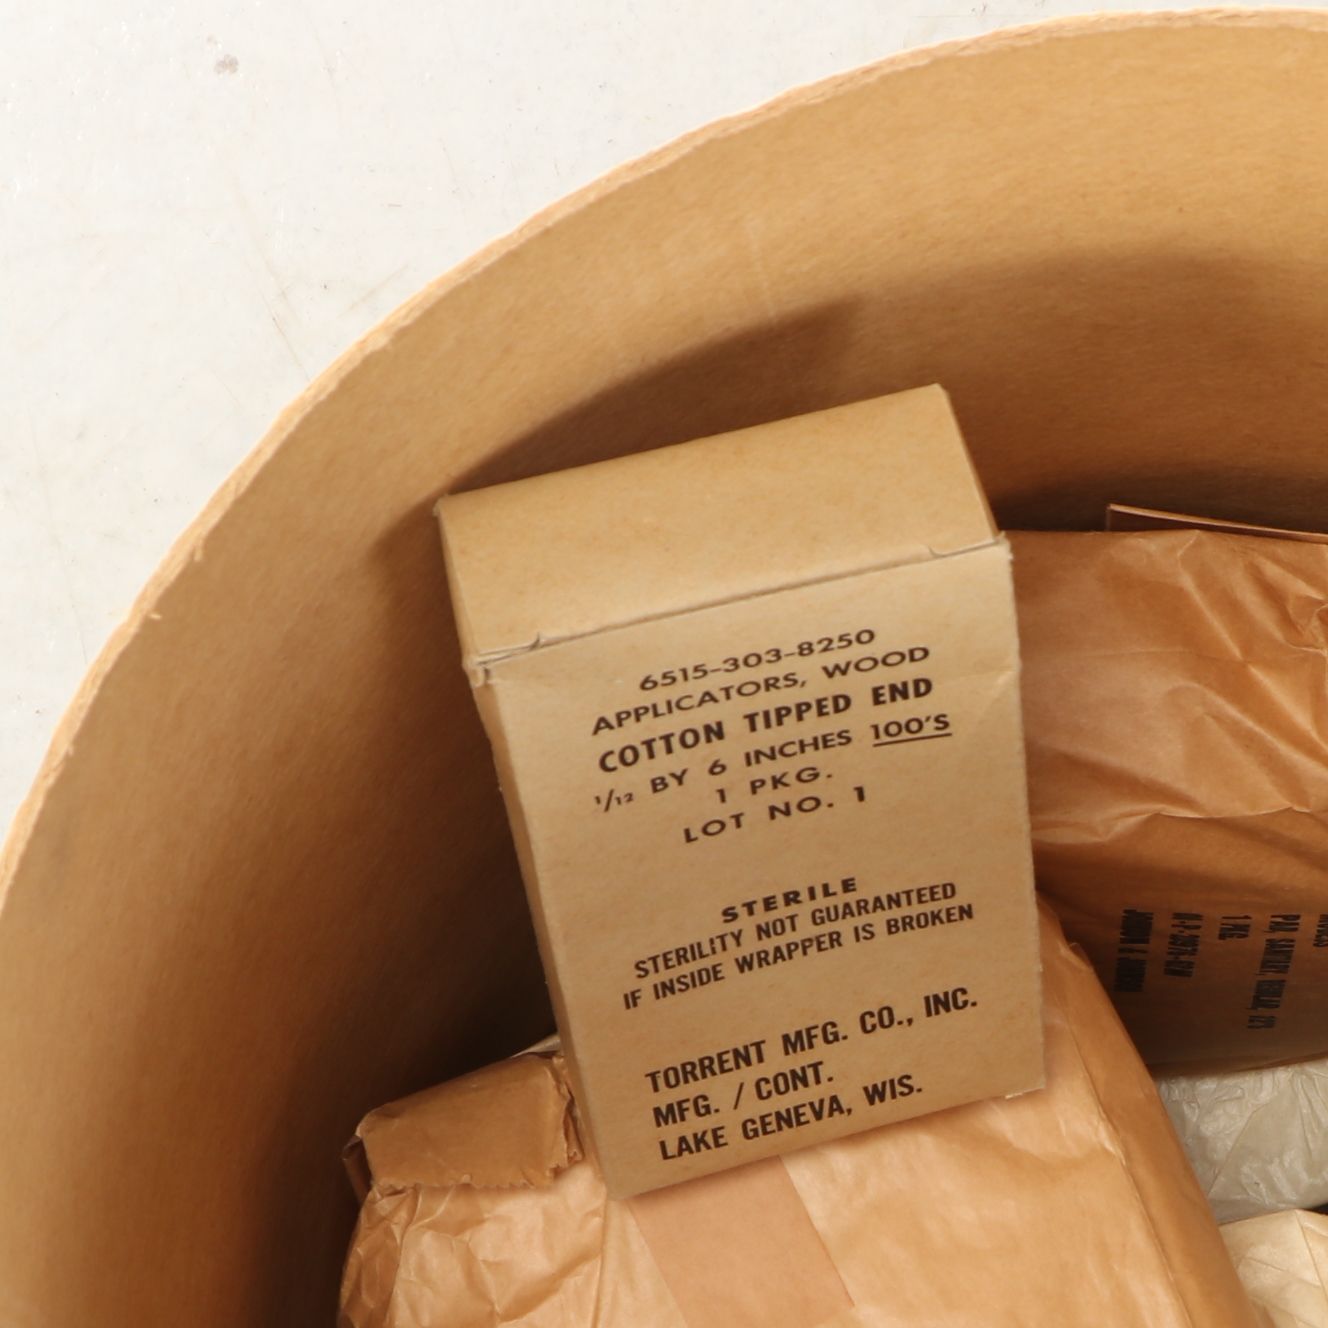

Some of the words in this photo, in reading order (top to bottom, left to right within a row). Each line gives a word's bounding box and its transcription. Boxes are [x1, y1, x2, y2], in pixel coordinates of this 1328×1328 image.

[592, 673, 806, 735] APPLICATORS,
[822, 647, 929, 678] WOOD
[640, 629, 875, 691] 6515-303-8250
[599, 721, 725, 772] COTTON
[743, 694, 851, 732] TIPPED
[872, 678, 932, 706] END
[651, 769, 688, 793] BY
[708, 759, 726, 776] 6
[745, 730, 852, 767] INCHES
[870, 714, 952, 747] 100'S
[684, 813, 744, 843] LOT
[768, 796, 833, 820] NO.
[854, 786, 865, 802] 1
[716, 789, 726, 803] 1
[750, 767, 832, 795] PKG.
[634, 929, 742, 979] STERILITY
[756, 914, 798, 941] NOT
[811, 883, 956, 926] GUARANTEED
[722, 877, 857, 923] STERILE
[624, 989, 641, 1010] IF
[653, 963, 725, 1000] INSIDE
[734, 931, 843, 974] WRAPPER
[854, 923, 875, 942] IS
[886, 904, 973, 935] BROKEN
[645, 1040, 766, 1093] TORRENT
[782, 1021, 848, 1056] MFG.
[859, 1007, 913, 1034] CO.,
[924, 988, 977, 1017] INC.
[653, 1095, 720, 1128] MFG.
[733, 1082, 744, 1110] /
[755, 1061, 833, 1100] CONT.
[659, 1126, 728, 1160] LAKE
[742, 1096, 852, 1140] GENEVA,
[862, 1074, 922, 1106] WIS.
